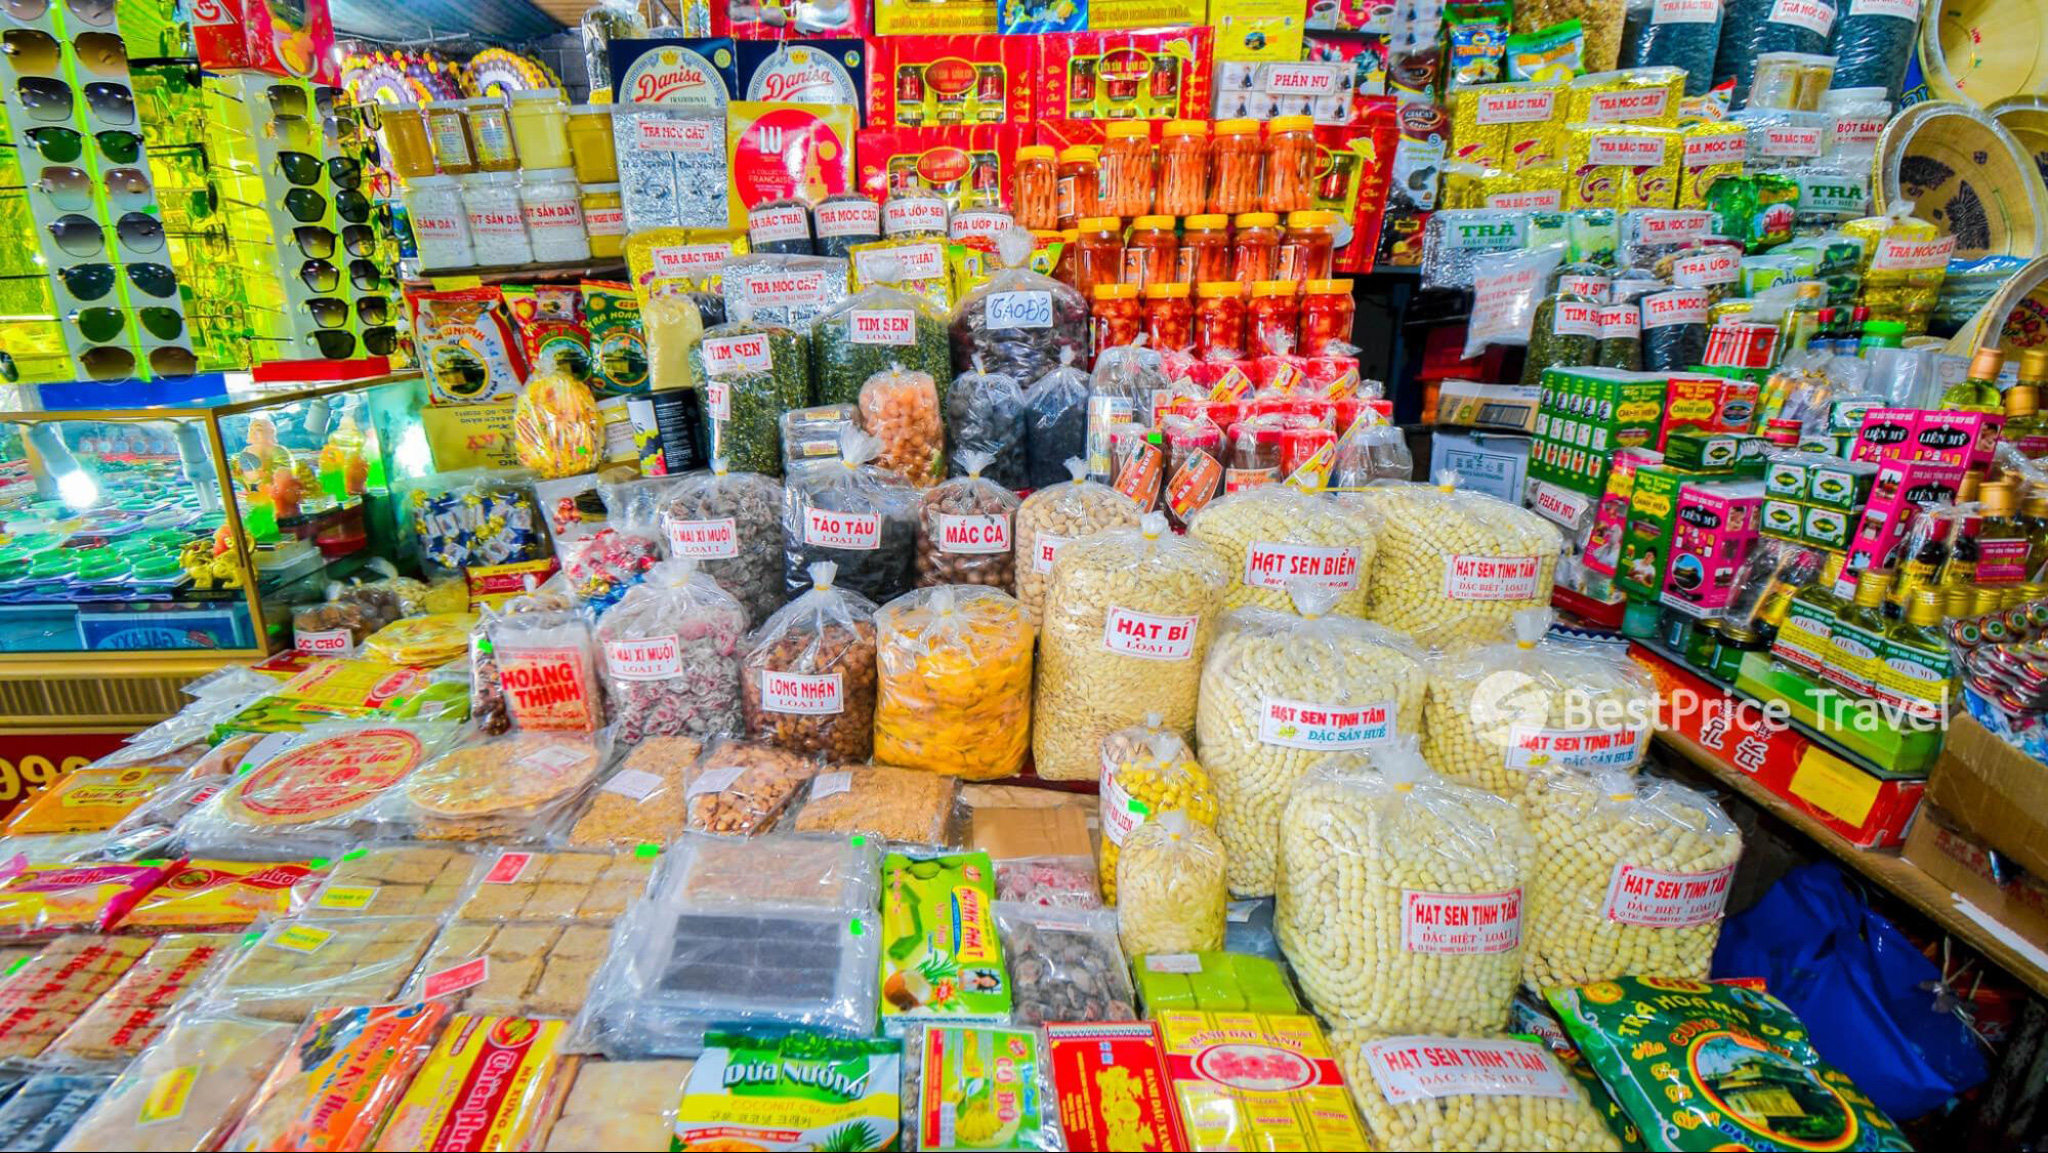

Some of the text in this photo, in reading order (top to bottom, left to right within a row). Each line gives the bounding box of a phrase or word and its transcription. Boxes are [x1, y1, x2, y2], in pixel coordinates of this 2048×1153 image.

[637, 69, 706, 99] Danisa
[767, 68, 834, 99] Danisa
[760, 126, 782, 154] LU
[857, 316, 910, 333] TIM SEN
[709, 343, 732, 361] TIM
[708, 388, 722, 405] EN
[1251, 548, 1356, 576] HẠT SEN BIỂN
[1456, 560, 1476, 581] HẠT
[1477, 561, 1495, 578] SEN
[1498, 563, 1519, 583] TỊNH
[1116, 616, 1189, 642] HẠT BÍ
[499, 661, 575, 691] HOÀNG
[769, 676, 798, 698] LONG
[513, 682, 581, 710] THỊNH
[1271, 704, 1296, 725] HẠT
[1300, 709, 1327, 726] SEN
[1331, 710, 1358, 728] TỊNH
[1553, 736, 1580, 752] SEN
[1583, 733, 1611, 753] TỊNH
[1623, 874, 1655, 900] HẠT
[1654, 880, 1682, 900] SEN
[1415, 902, 1442, 931] HẠT
[1444, 904, 1469, 927] SEN
[1472, 903, 1498, 932] TỊNH
[1383, 1048, 1422, 1076] HẠT
[1423, 1047, 1464, 1067] SEN
[1461, 1048, 1509, 1073] TỊNH
[722, 1057, 869, 1101] Dừa Nướng
